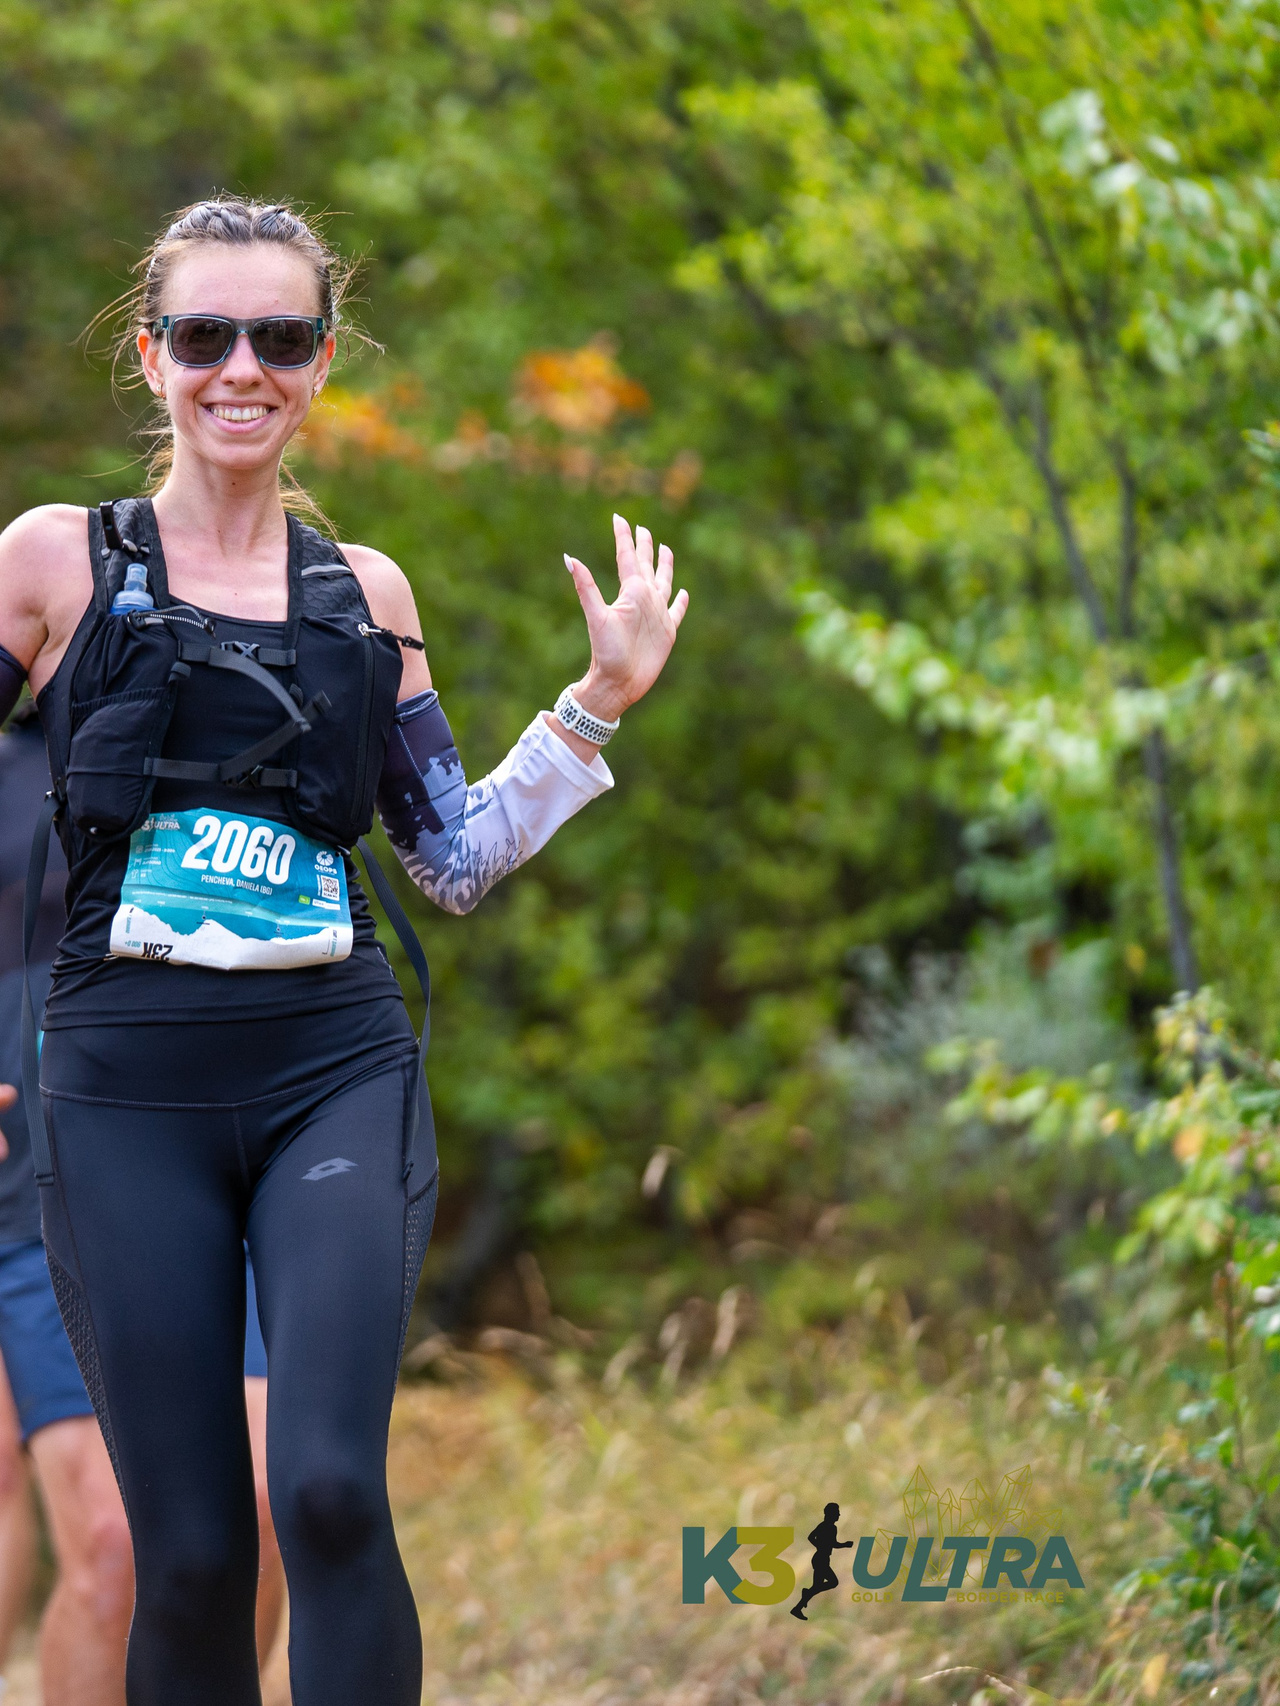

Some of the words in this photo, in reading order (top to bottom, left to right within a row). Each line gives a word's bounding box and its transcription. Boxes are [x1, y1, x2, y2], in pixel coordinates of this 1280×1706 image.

[154, 821, 180, 830] ULTRA
[181, 815, 296, 885] 2060
[201, 874, 234, 887] PENCHEVA,
[236, 878, 260, 892] DANIELA
[260, 884, 273, 896] (BG)
[141, 942, 173, 961] 23K
